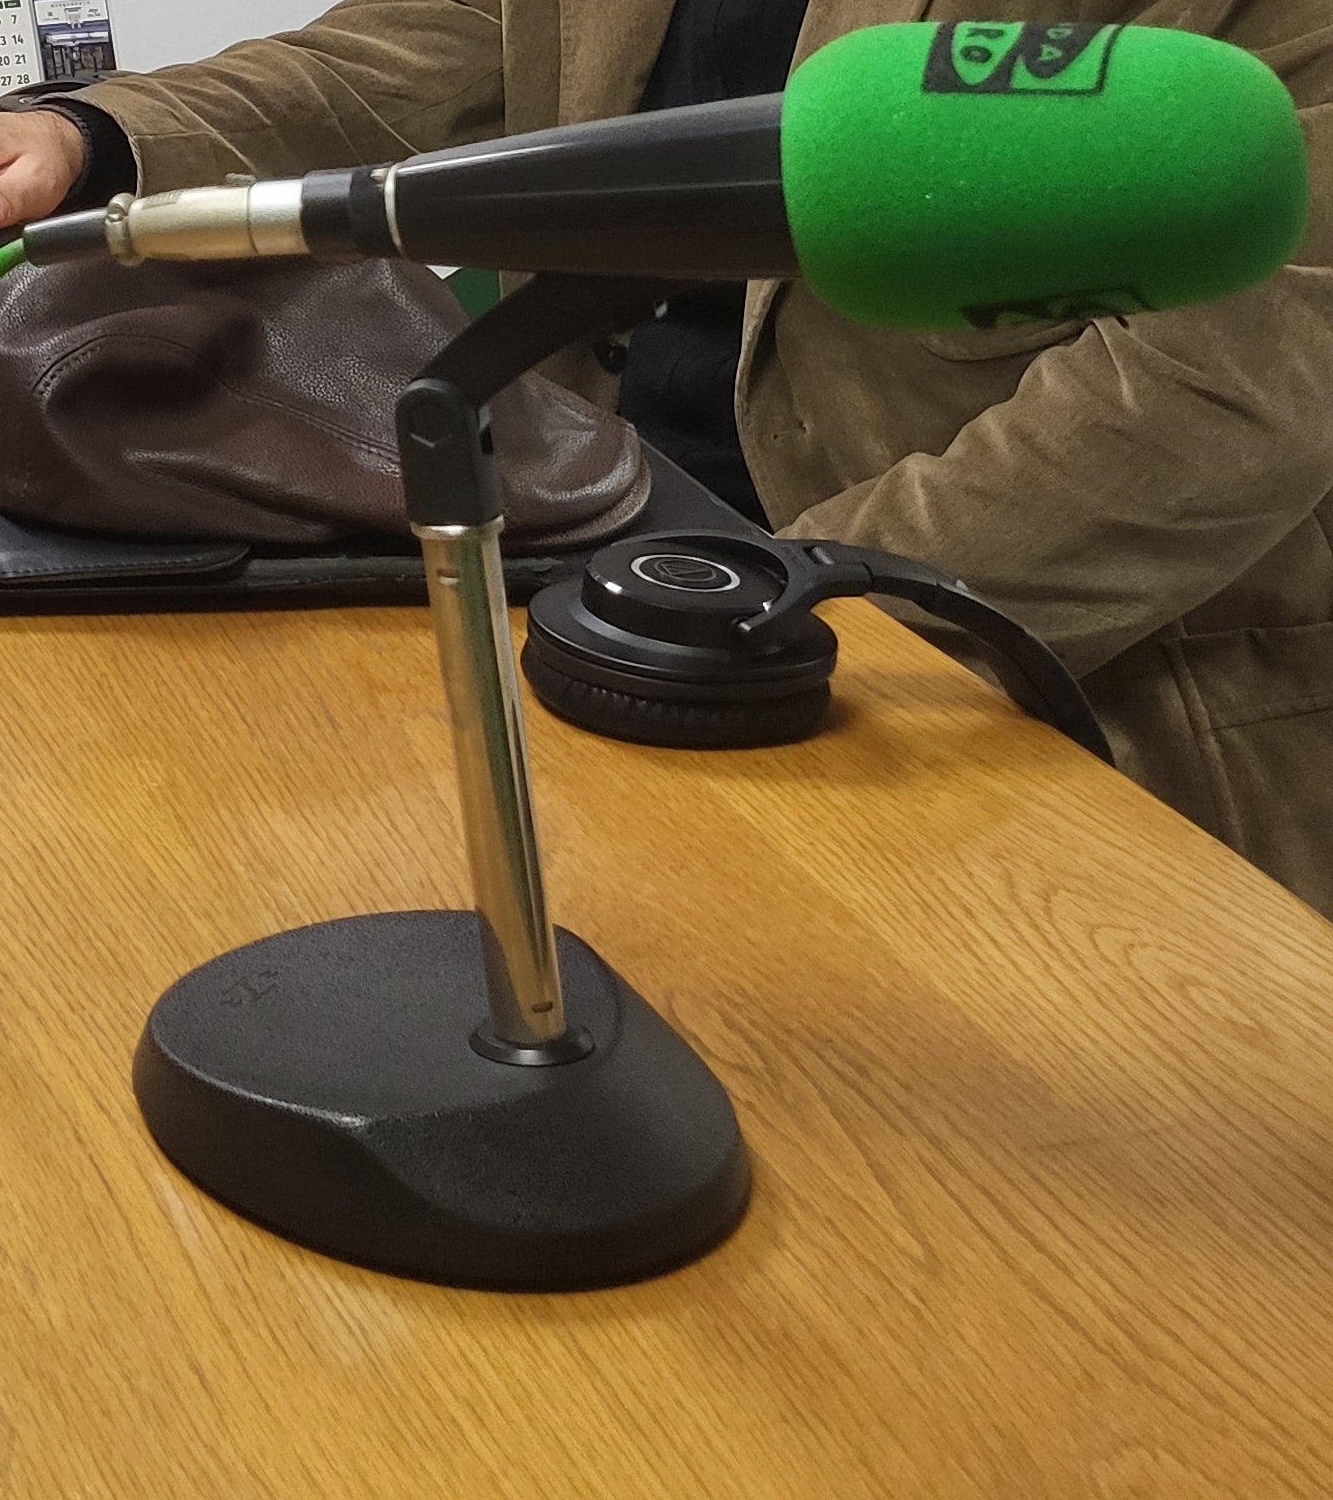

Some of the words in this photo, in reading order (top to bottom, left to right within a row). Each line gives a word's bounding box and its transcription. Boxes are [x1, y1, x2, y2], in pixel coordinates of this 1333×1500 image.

[11, 15, 17, 24] 7
[12, 34, 24, 44] 14
[15, 54, 26, 64] 21
[0, 76, 12, 86] 27
[17, 74, 30, 84] 28
